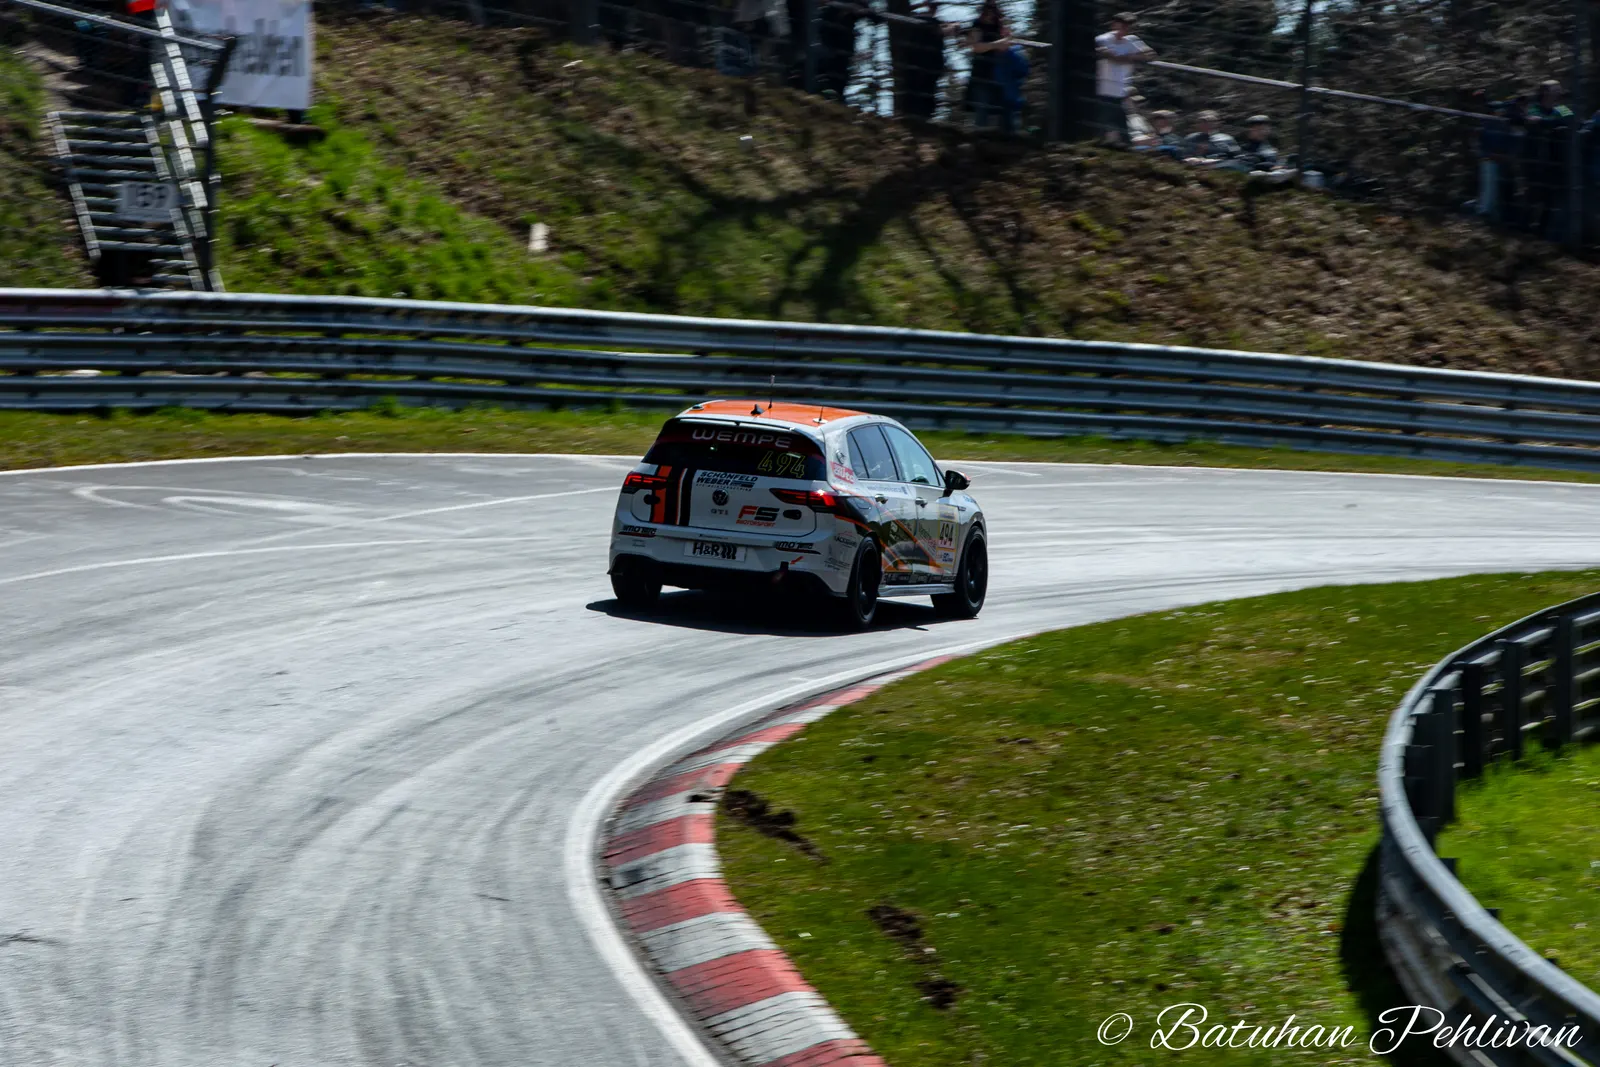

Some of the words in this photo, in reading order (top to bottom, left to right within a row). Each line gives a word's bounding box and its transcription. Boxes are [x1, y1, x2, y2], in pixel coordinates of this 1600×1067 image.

[692, 428, 792, 448] WEMPE
[758, 450, 806, 478] 494
[696, 477, 731, 486] WEBER
[700, 471, 758, 482] SCHÖNFELD
[710, 508, 729, 516] GTI
[738, 505, 780, 522] FS
[692, 541, 720, 557] H&R
